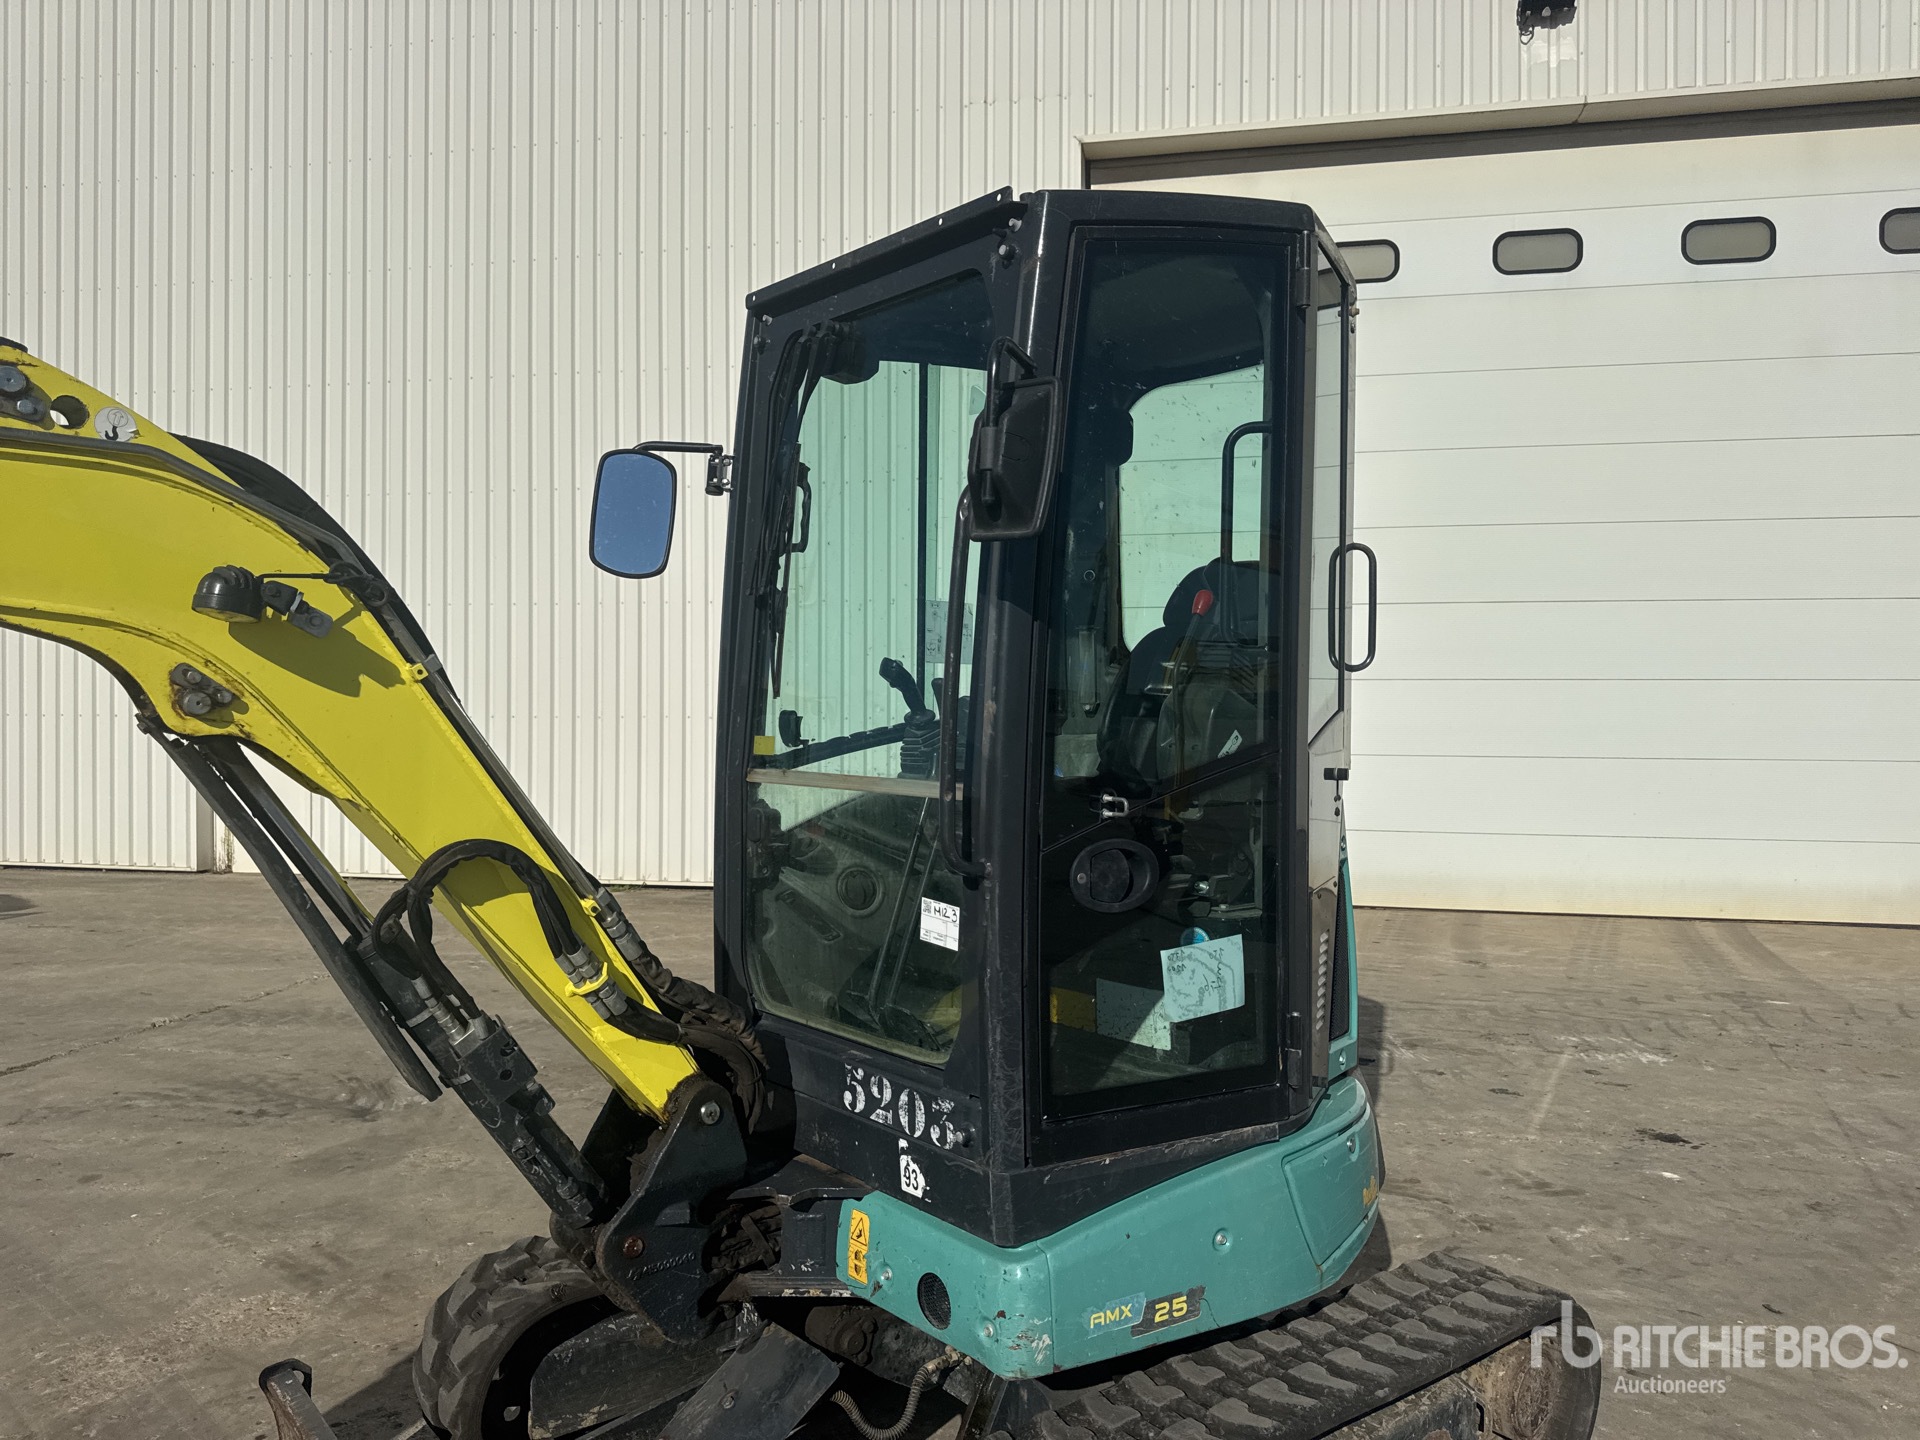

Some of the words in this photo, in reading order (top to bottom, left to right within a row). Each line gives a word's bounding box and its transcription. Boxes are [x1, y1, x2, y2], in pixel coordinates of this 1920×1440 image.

[952, 909, 958, 922] 3
[904, 1165, 919, 1190] 93
[1090, 1303, 1133, 1329] AMX
[1154, 1295, 1188, 1323] 25
